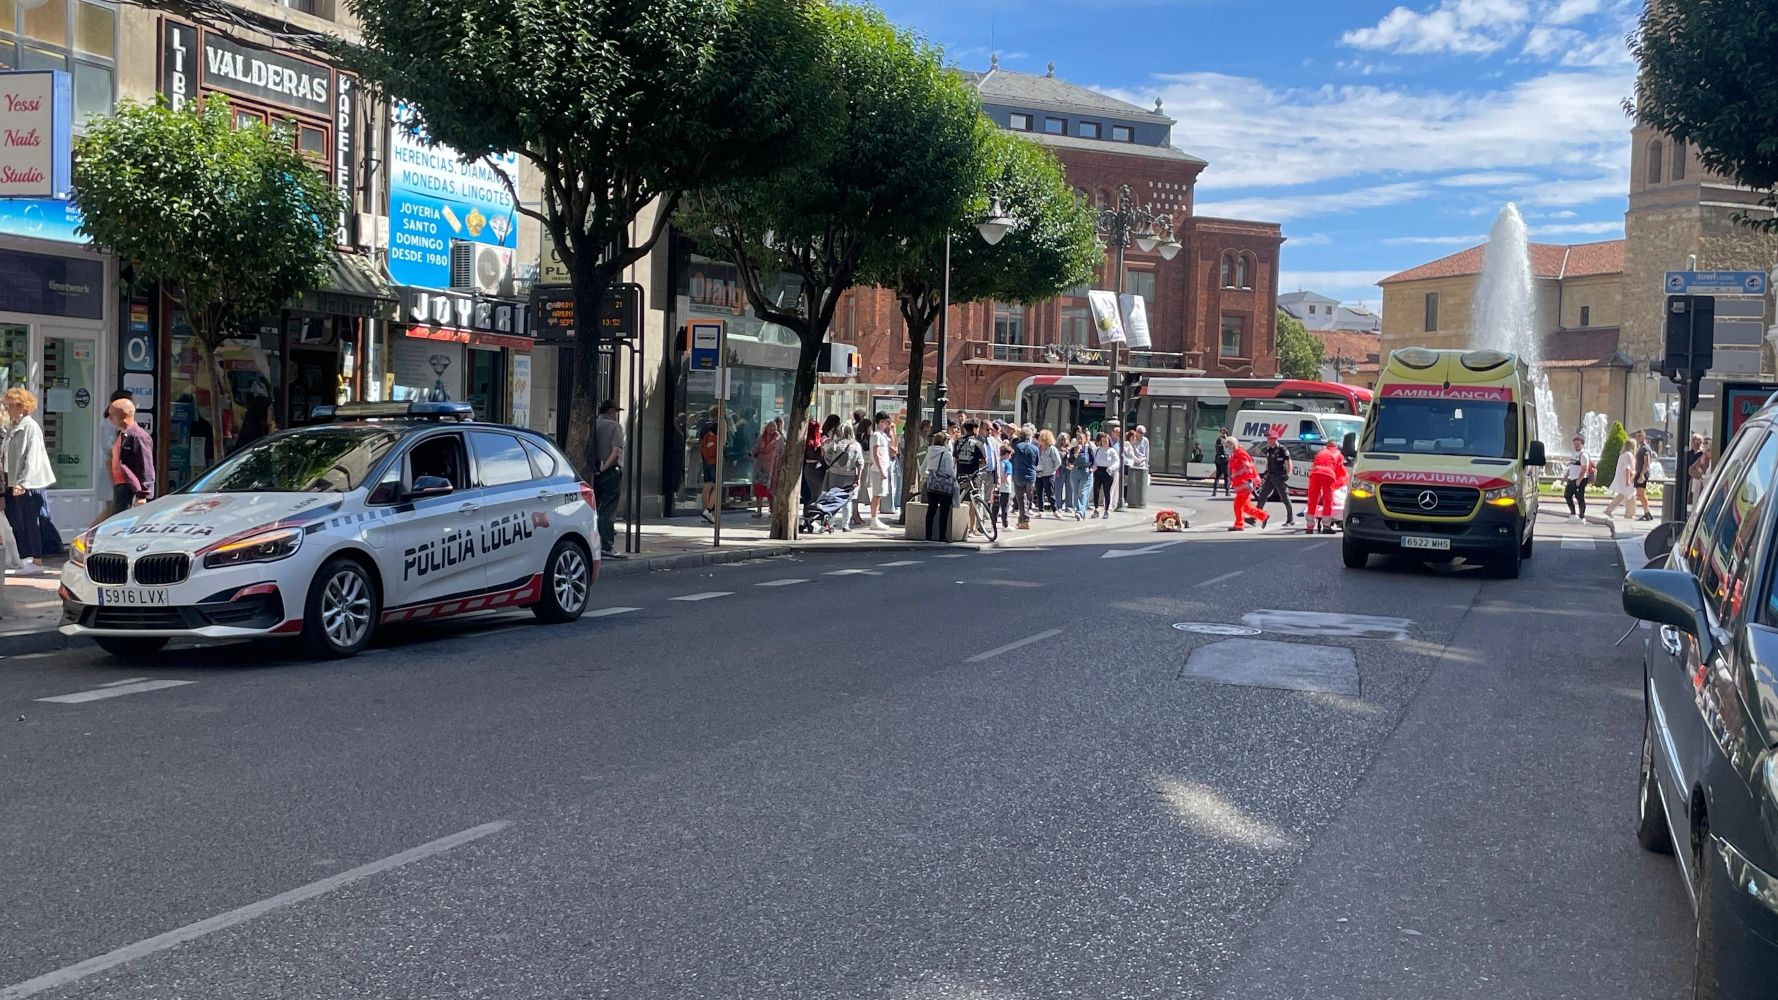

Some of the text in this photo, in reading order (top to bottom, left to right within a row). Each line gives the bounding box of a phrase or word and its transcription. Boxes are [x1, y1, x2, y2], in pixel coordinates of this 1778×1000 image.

[173, 28, 186, 113] LIBR
[206, 46, 328, 103] VALDERAS
[5, 94, 42, 112] Yessi
[4, 128, 41, 147] Nails
[0, 166, 45, 184] Studio
[462, 184, 511, 206] LINGOTES
[403, 218, 437, 235] SANTO
[396, 232, 444, 250] DOMINGO
[391, 247, 448, 267] DESDE 1980
[49, 280, 90, 294] finetwork
[411, 293, 531, 334] JOYERI
[1390, 388, 1502, 400] AMBULANCIA
[1242, 422, 1289, 438] MRW
[480, 511, 533, 554] LOCAL
[1407, 538, 1428, 547] 6522
[105, 590, 165, 604] 5916 LVX
